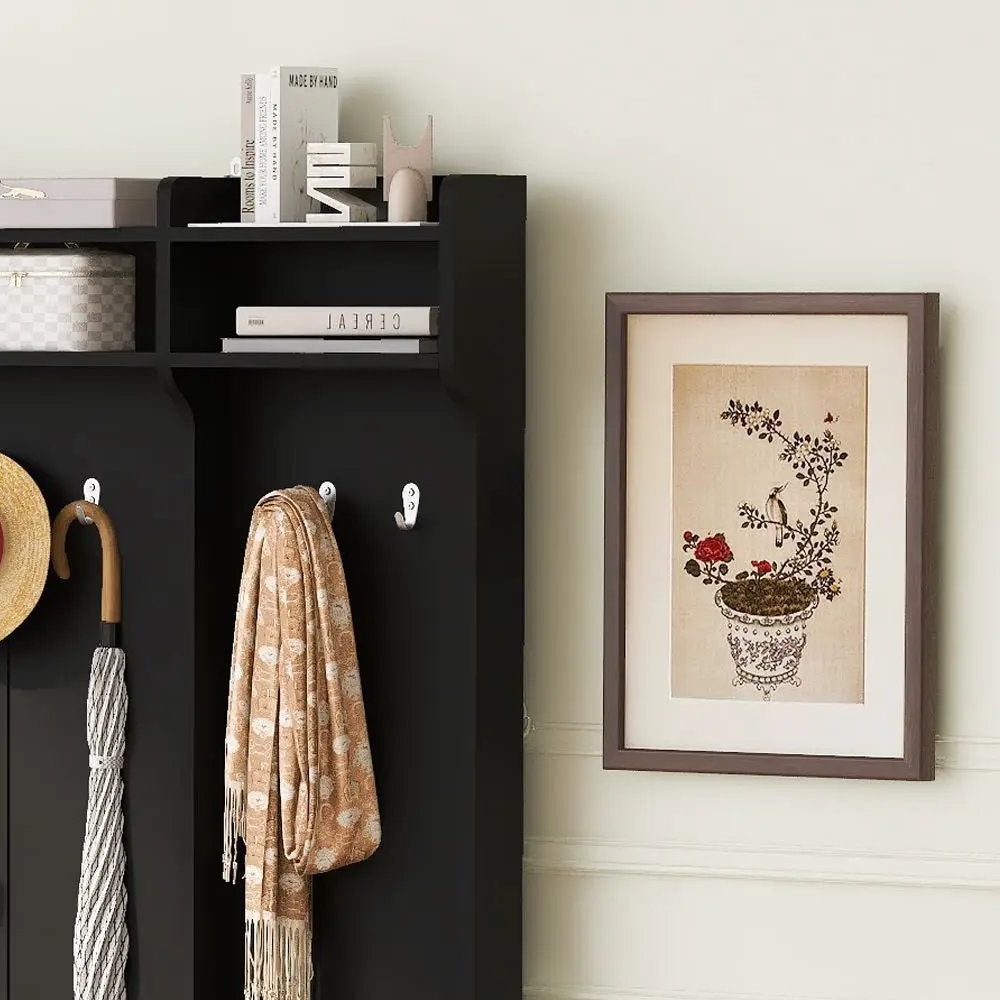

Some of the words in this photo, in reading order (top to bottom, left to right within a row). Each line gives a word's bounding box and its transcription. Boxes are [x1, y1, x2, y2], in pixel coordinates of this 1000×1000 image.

[288, 74, 308, 88] MADE
[309, 74, 318, 88] BY
[319, 75, 338, 89] HAND
[272, 136, 278, 148] BY
[241, 139, 255, 171] Inspire
[244, 171, 255, 181] to
[242, 182, 255, 215] Rooms
